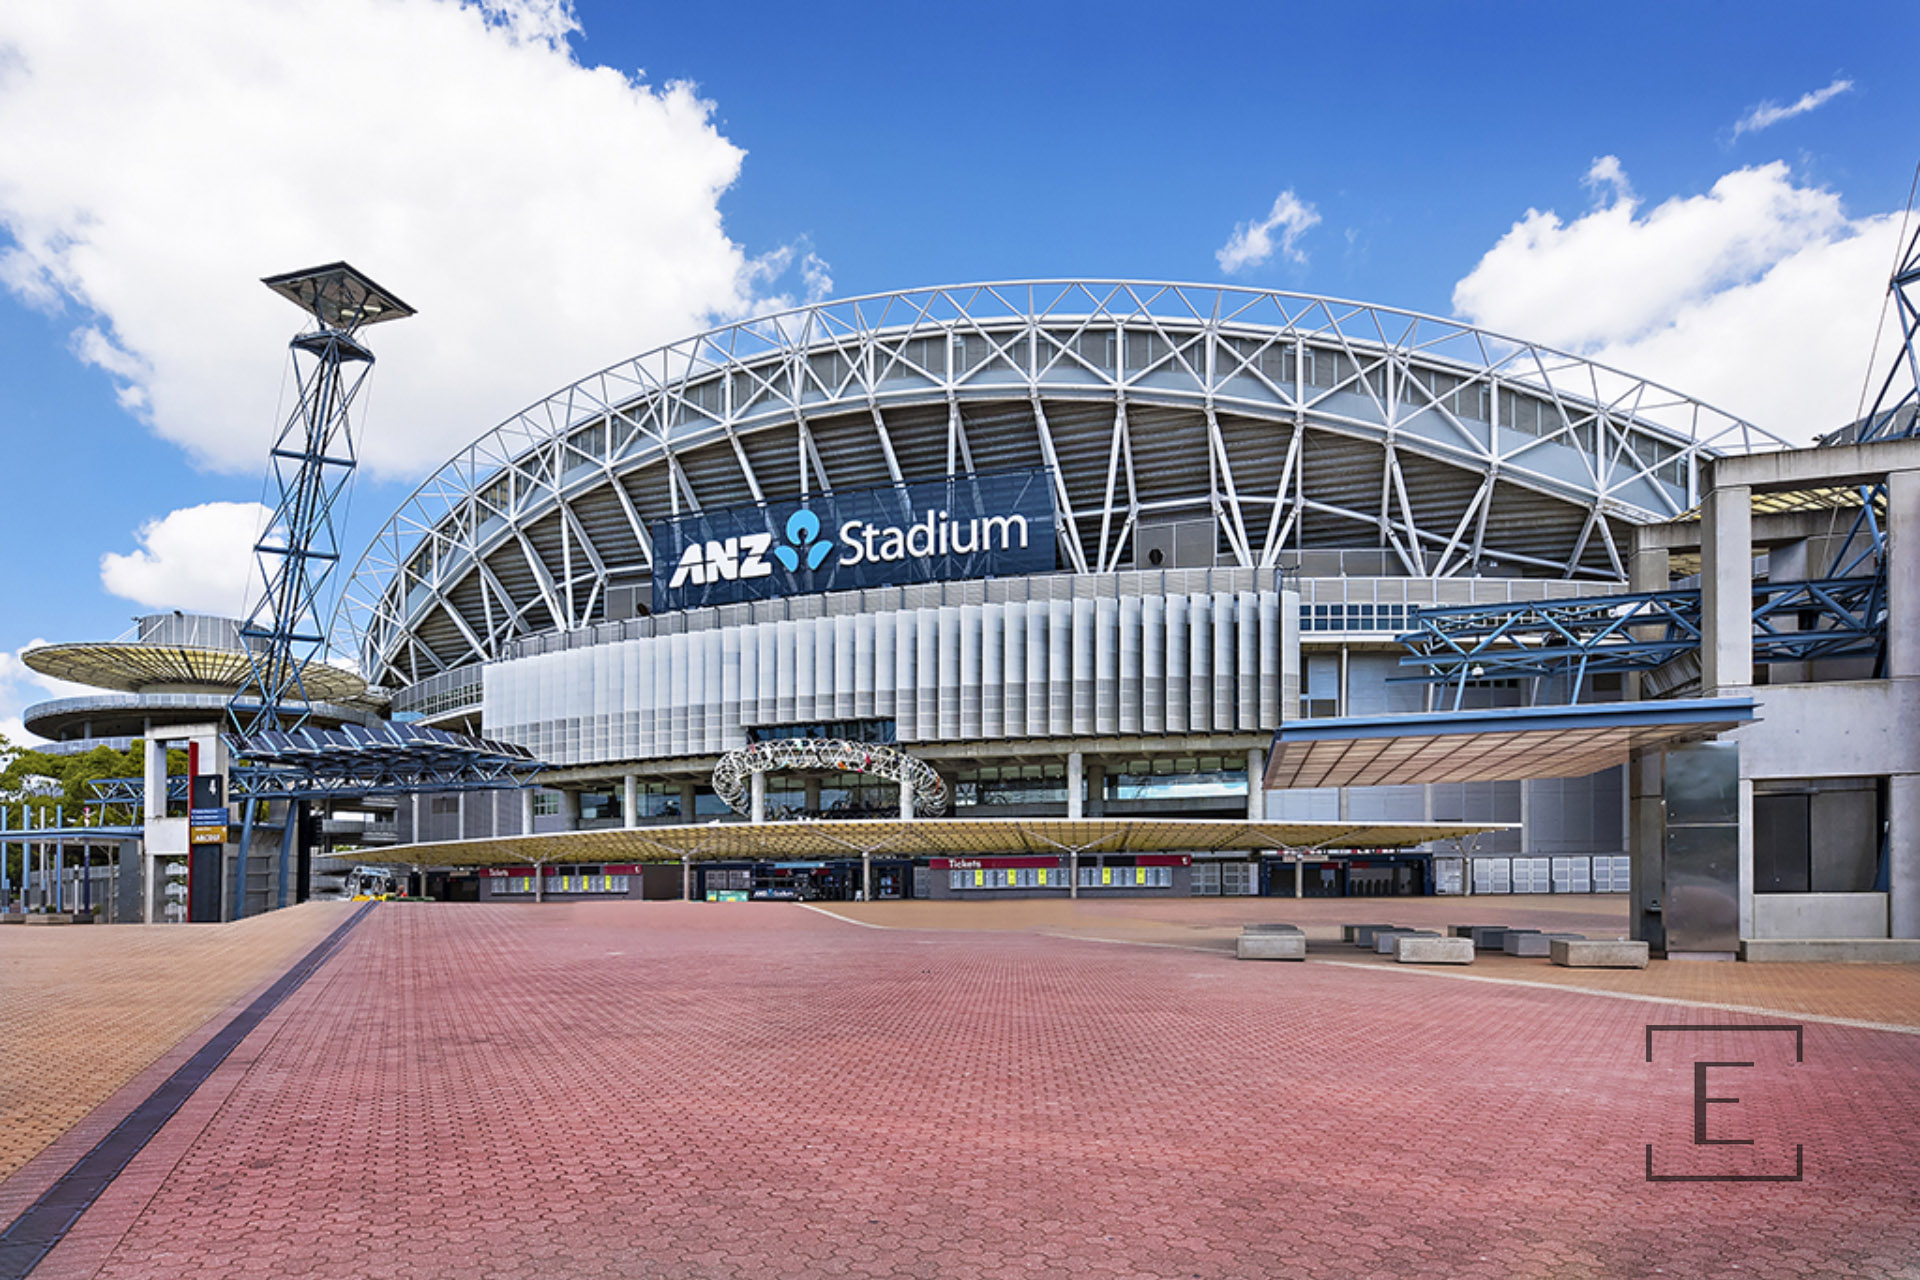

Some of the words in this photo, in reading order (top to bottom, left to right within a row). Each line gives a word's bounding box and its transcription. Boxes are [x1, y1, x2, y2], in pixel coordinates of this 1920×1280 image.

[669, 533, 772, 588] ANZ
[838, 509, 1028, 566] Stadium
[948, 859, 982, 869] Tickets
